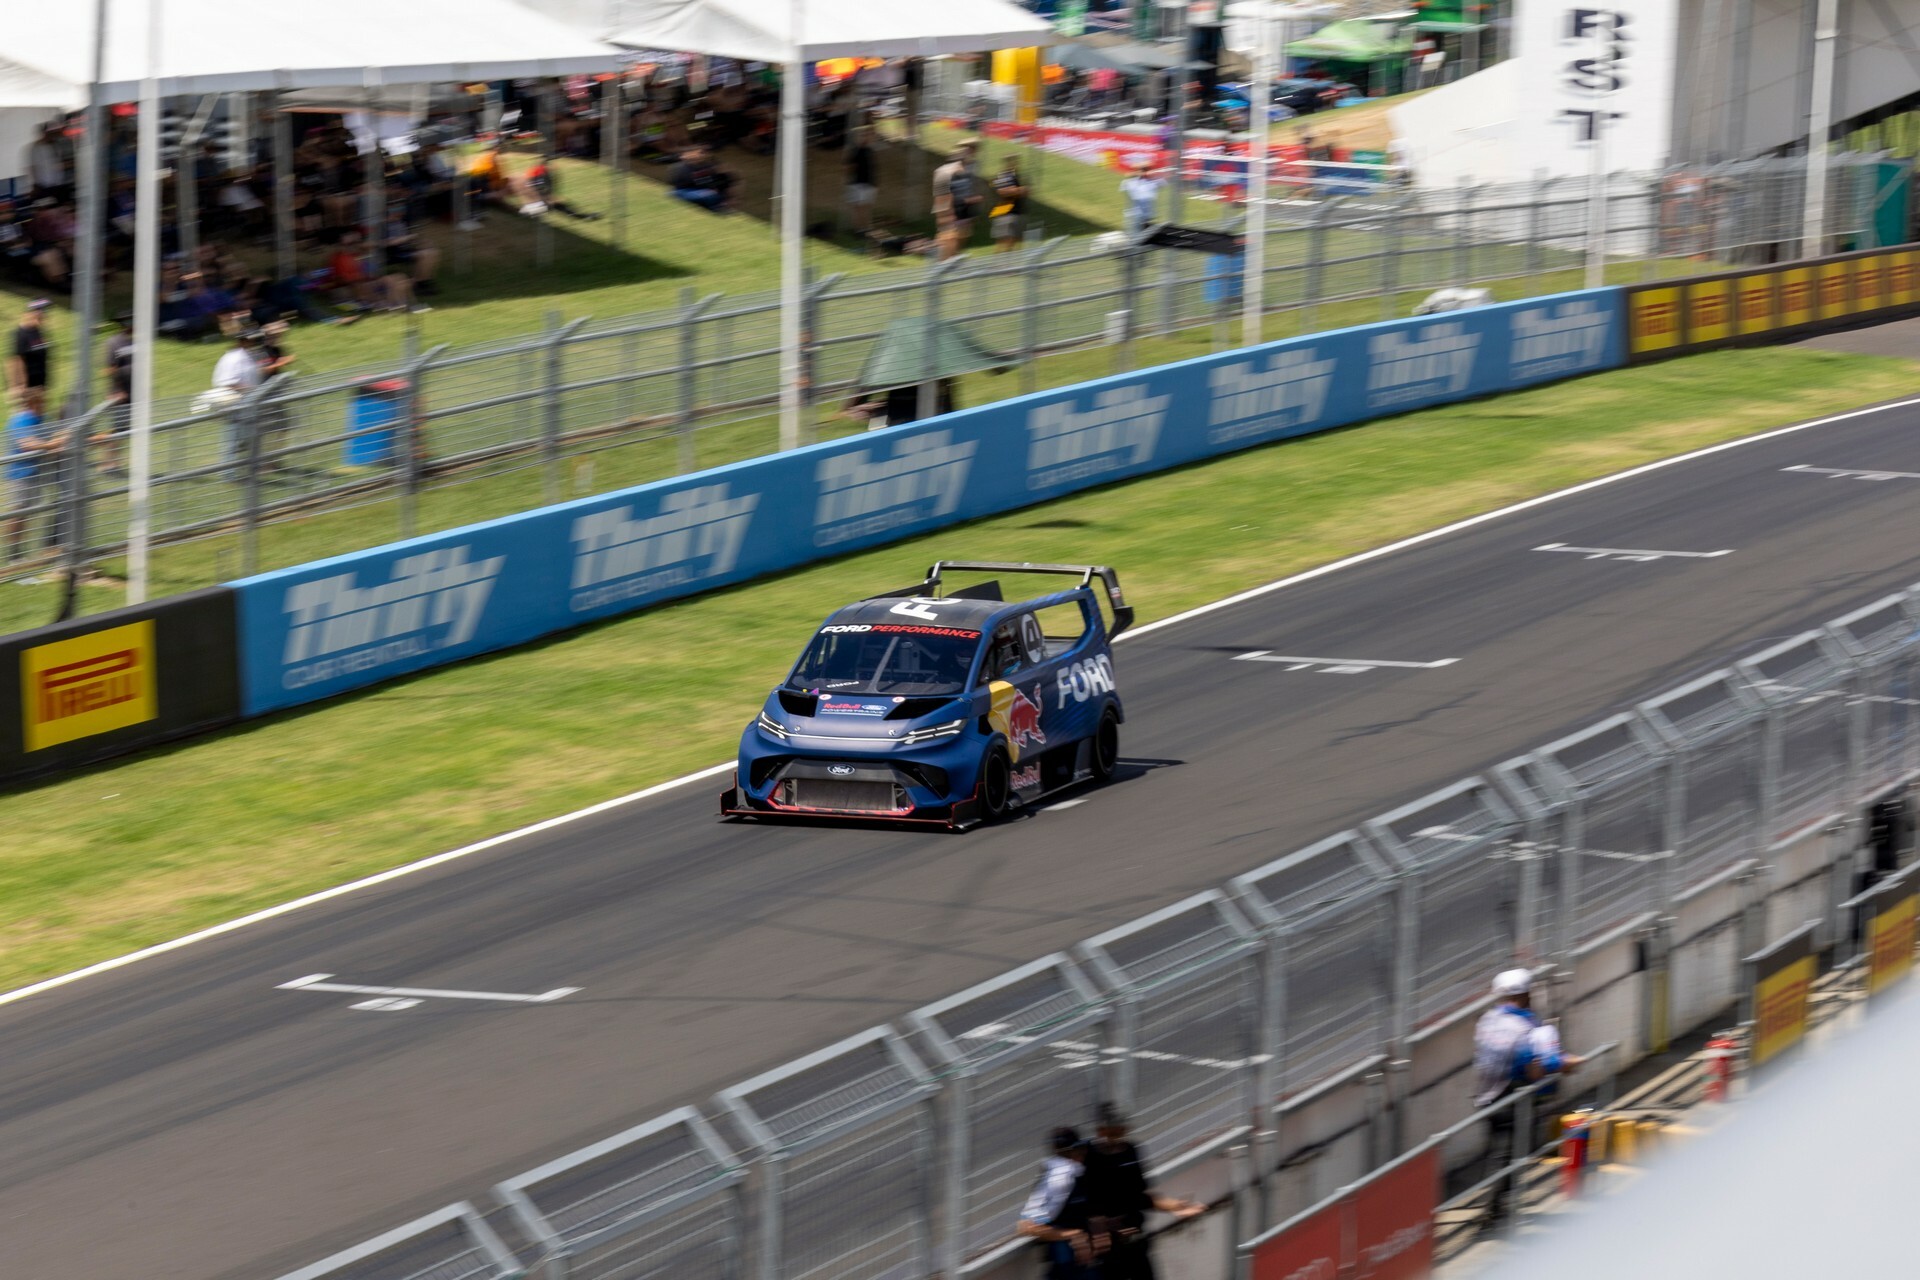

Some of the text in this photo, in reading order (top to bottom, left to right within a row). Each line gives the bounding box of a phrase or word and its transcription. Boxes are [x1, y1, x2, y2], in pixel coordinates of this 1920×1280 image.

[820, 625, 981, 639] FORD PERFORMANCE
[1057, 654, 1115, 709] FORD
